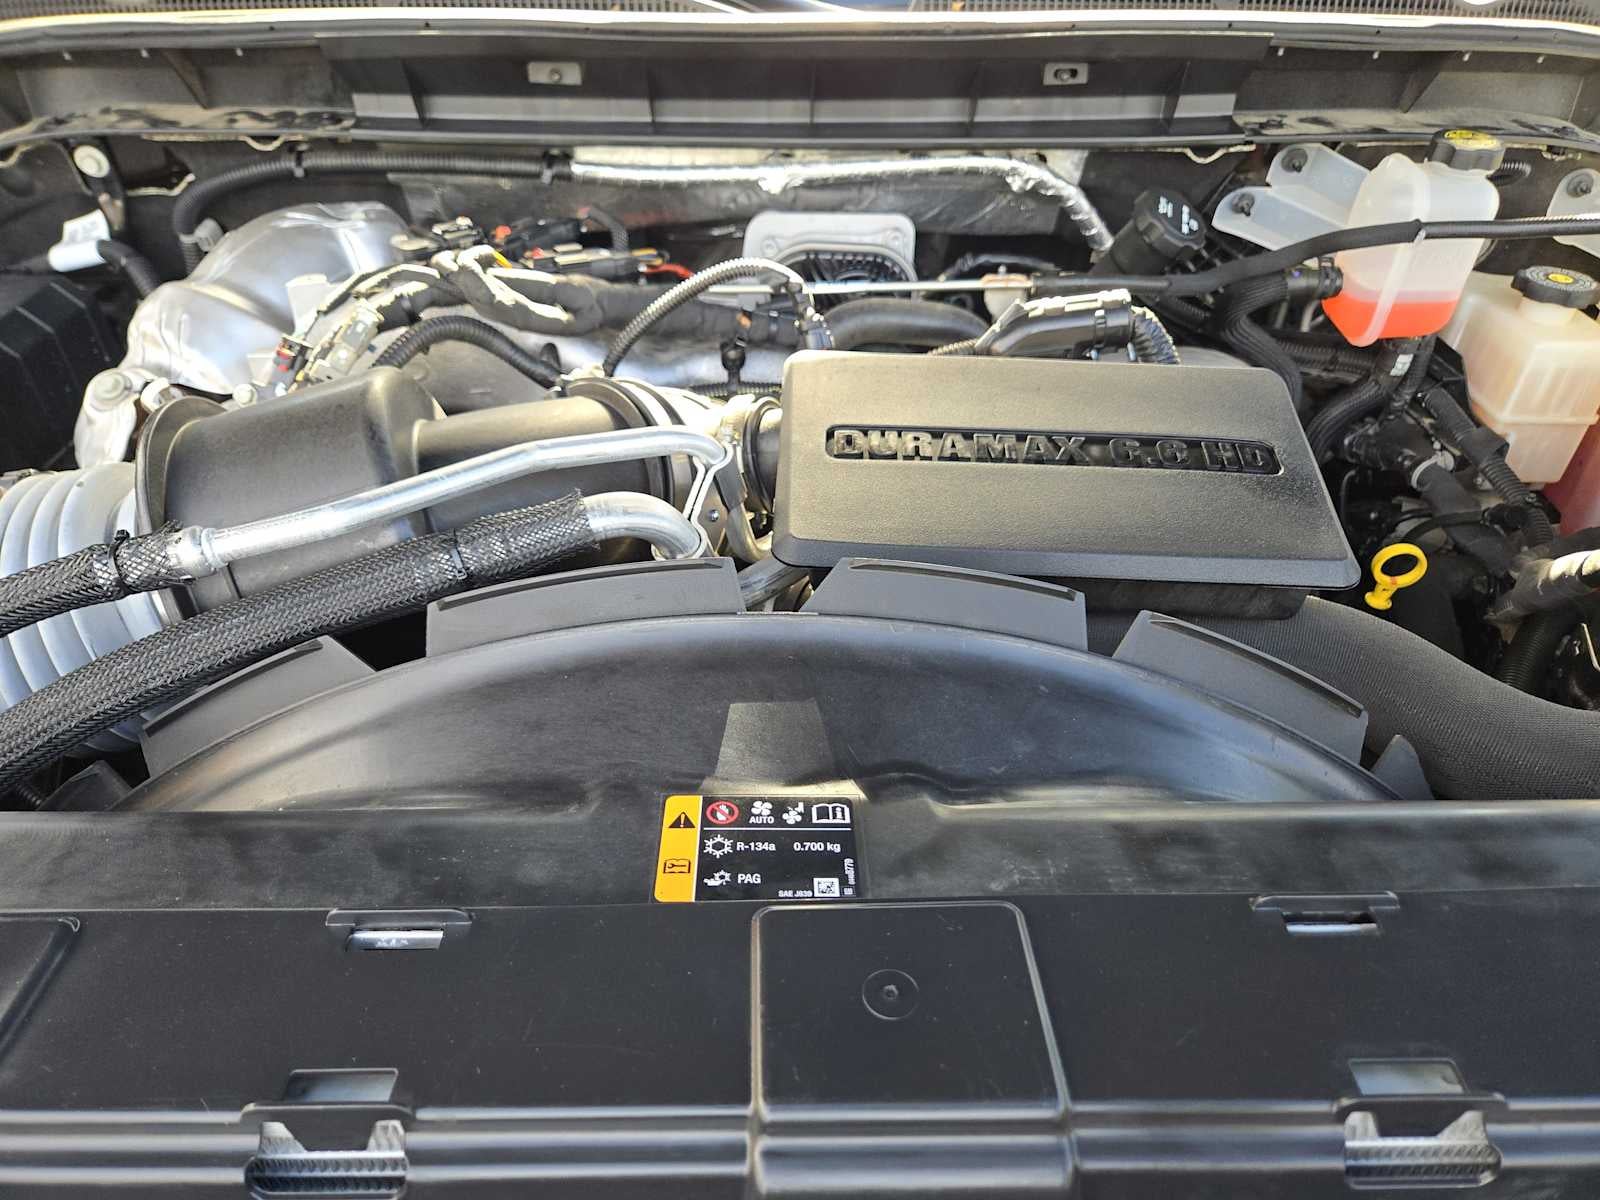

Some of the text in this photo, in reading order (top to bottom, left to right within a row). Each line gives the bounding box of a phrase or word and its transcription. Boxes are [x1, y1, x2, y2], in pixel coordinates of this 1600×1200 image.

[833, 429, 1274, 474] DURAMAX 6.6 HD
[749, 815, 774, 824] AUTO
[736, 841, 841, 853] R-134a 0.700 kg
[738, 873, 761, 884] PAG
